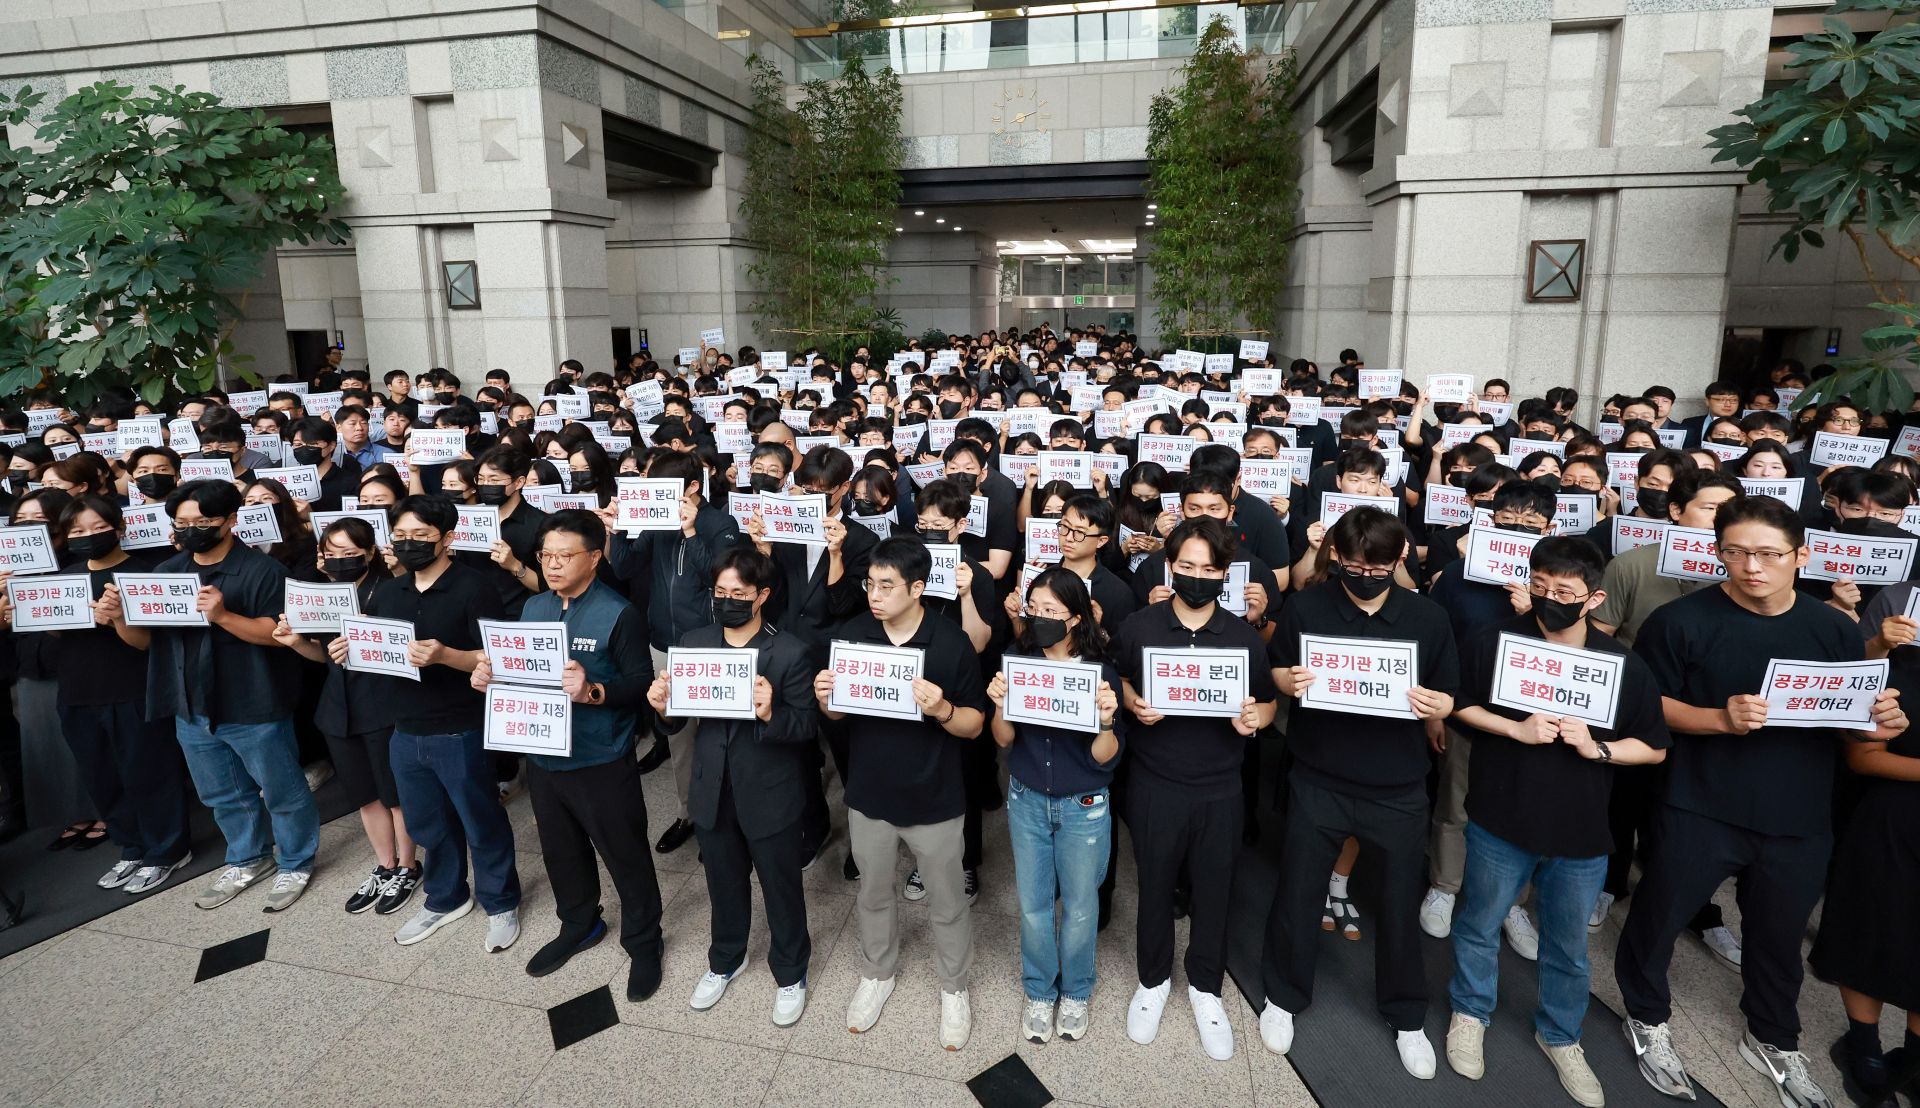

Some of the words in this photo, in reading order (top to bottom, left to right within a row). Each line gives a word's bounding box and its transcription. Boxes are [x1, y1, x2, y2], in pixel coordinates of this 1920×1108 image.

[1133, 404, 1158, 413] 비대위를
[119, 425, 140, 435] 공공기관
[142, 424, 157, 434] 지정
[178, 425, 190, 434] 지정
[725, 428, 749, 436] 비대위를
[124, 437, 150, 445] 철회하라
[414, 437, 443, 445] 공공기관
[447, 437, 461, 445] 지정
[1143, 442, 1174, 450] 공공기관
[1176, 443, 1191, 452] 지정
[1819, 439, 1858, 451] 공공기관
[1862, 444, 1881, 453] 지정
[423, 448, 453, 457] 철회하라
[1152, 454, 1182, 463] 철회하라
[1297, 455, 1309, 463] 지정
[1828, 453, 1866, 464] 철회하라
[1050, 459, 1080, 467] 비대위를
[182, 466, 211, 476] 공공기관
[213, 466, 229, 475] 지정
[914, 468, 934, 479] 금소원
[1271, 468, 1287, 476] 지정
[292, 473, 313, 484] 분리
[1245, 480, 1277, 488] 철회하라
[290, 488, 308, 497] 하라
[525, 494, 539, 502] 기관
[620, 490, 650, 501] 금소원
[655, 490, 675, 501] 분리
[553, 501, 586, 510] 비대위를
[764, 504, 793, 517] 금소원
[797, 506, 818, 518] 분리
[1556, 503, 1578, 513] 위를
[124, 512, 157, 525] 대위를
[244, 513, 267, 524] 분리
[629, 508, 669, 519] 철회하라
[473, 516, 492, 527] 분리
[773, 520, 815, 534] 철회하라
[868, 522, 885, 532] 지정
[1558, 518, 1579, 528] 하라
[240, 528, 264, 540] 하라
[20, 536, 43, 547] 지정
[1489, 540, 1530, 559] 비대위
[1813, 540, 1861, 557] 금소원
[1871, 547, 1903, 560] 분리
[934, 556, 954, 569] 지정
[1487, 559, 1530, 576] 구성하
[1824, 560, 1887, 577] 철회하라
[926, 572, 944, 584] 하라
[15, 588, 61, 601] 공공기관
[64, 586, 85, 598] 지정
[126, 584, 163, 596] 금소원
[168, 584, 194, 596] 분리
[288, 593, 324, 606] 공공기관
[328, 595, 349, 606] 지정
[31, 605, 74, 618] 철회하라
[140, 602, 188, 615] 철회하라
[348, 628, 383, 643] 금소원
[388, 632, 409, 644] 분리
[490, 635, 526, 649] 금소원
[532, 637, 558, 650] 분리
[360, 648, 405, 665] 철회하라
[1310, 651, 1372, 672] 공공기관
[1377, 657, 1408, 675] 지정
[502, 656, 551, 672] 철회하라
[673, 663, 721, 678] 공공기관
[726, 663, 749, 678] 지정
[836, 659, 886, 677] 공공기관
[889, 664, 914, 681] 지정
[1509, 651, 1562, 677] 금소원
[1572, 664, 1608, 686] 분리
[1156, 662, 1200, 679] 금소원
[1209, 665, 1238, 680] 분리
[1013, 671, 1055, 688] 금소원
[1063, 676, 1090, 693] 분리
[1328, 678, 1390, 698] 철회하라
[1774, 674, 1843, 690] 공공기관
[1847, 675, 1879, 690] 지정
[688, 685, 736, 700] 철회하라
[849, 684, 899, 702] 철회하라
[1168, 686, 1227, 704] 철회하라
[1520, 680, 1592, 709] 철회하라
[493, 698, 539, 715] 공공기관
[542, 703, 565, 717] 지정
[1023, 695, 1080, 715] 철회하라
[1786, 697, 1853, 711] 철회하라
[505, 722, 551, 738] 철회하라
